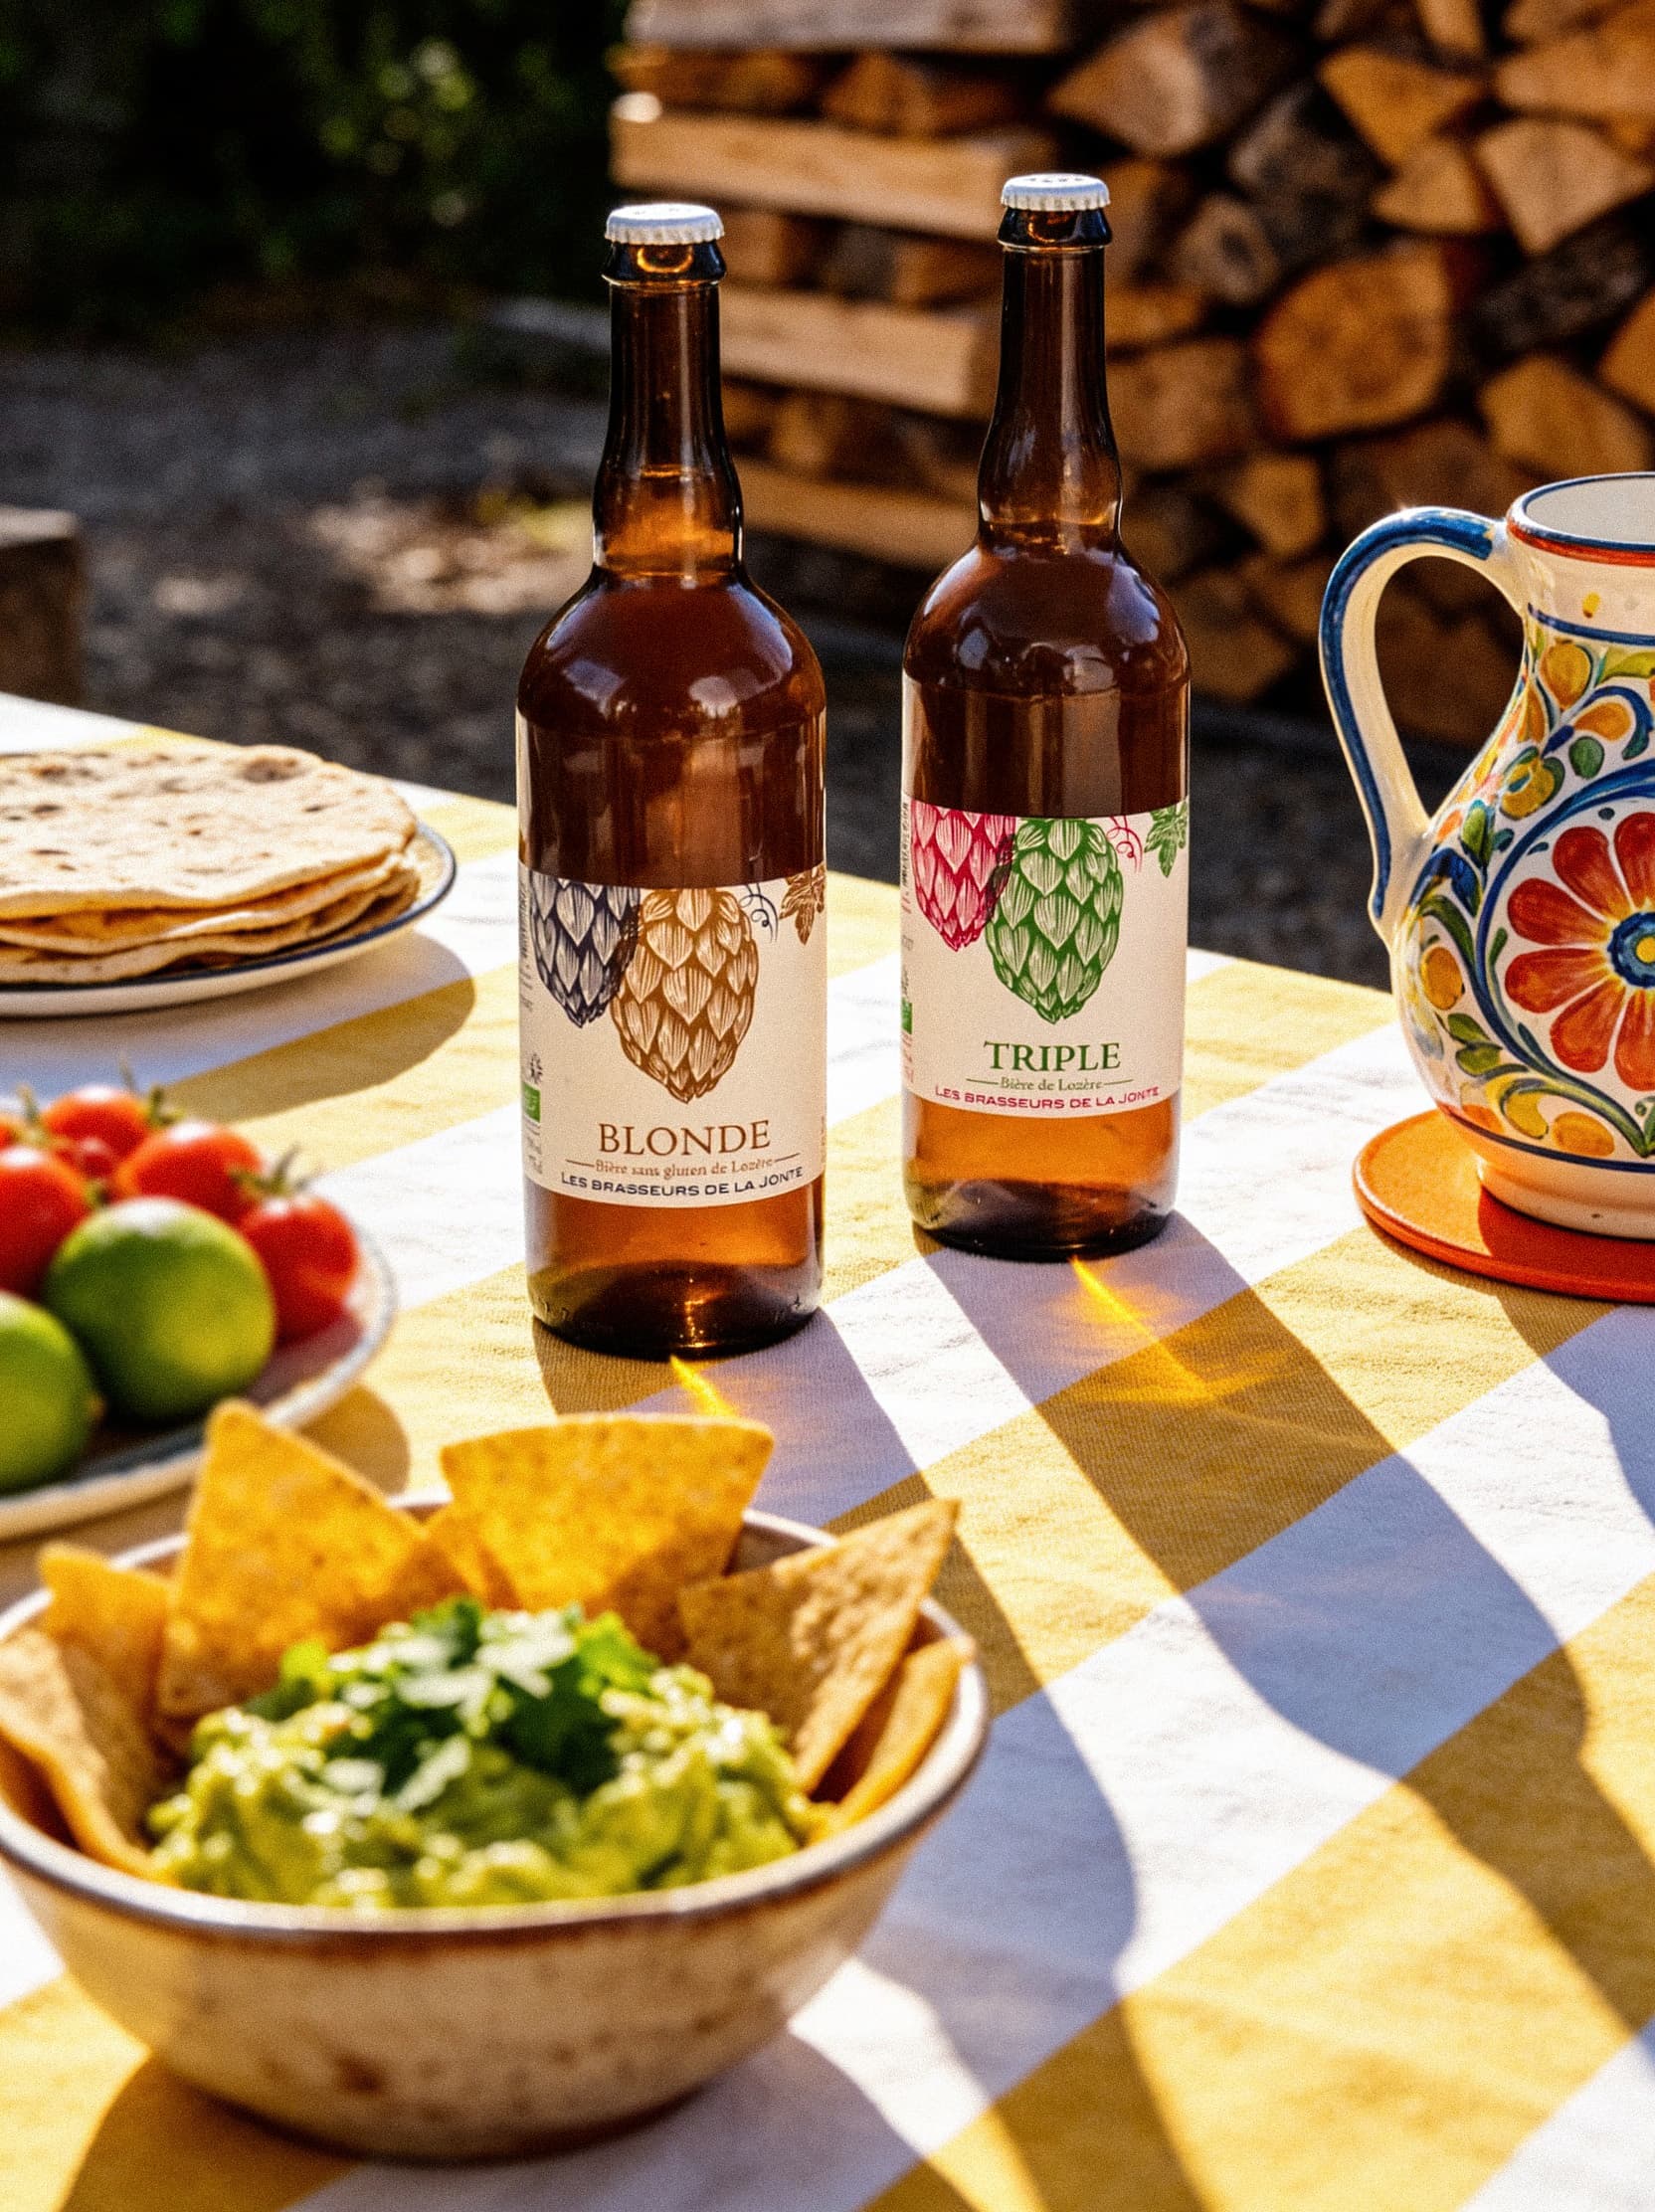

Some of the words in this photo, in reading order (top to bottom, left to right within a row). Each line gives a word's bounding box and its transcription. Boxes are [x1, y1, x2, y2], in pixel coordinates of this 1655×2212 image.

[984, 1040, 1121, 1072] TRIPLE
[935, 1085, 960, 1100] LES
[965, 1092, 1065, 1109] BRASSEURS
[1070, 1097, 1091, 1108] DE
[1096, 1096, 1115, 1107] LA
[1118, 1086, 1160, 1104] JONTE
[1001, 1076, 1033, 1090] Bière
[1037, 1077, 1054, 1091] de
[1058, 1078, 1103, 1091] Lozère
[598, 1119, 771, 1157] BLONDE
[711, 1162, 727, 1174] de
[561, 1172, 588, 1189] LES
[592, 1180, 700, 1197] BRASSEURS
[705, 1184, 729, 1196] DE
[735, 1181, 754, 1193] LA
[759, 1167, 803, 1189] JONTE
